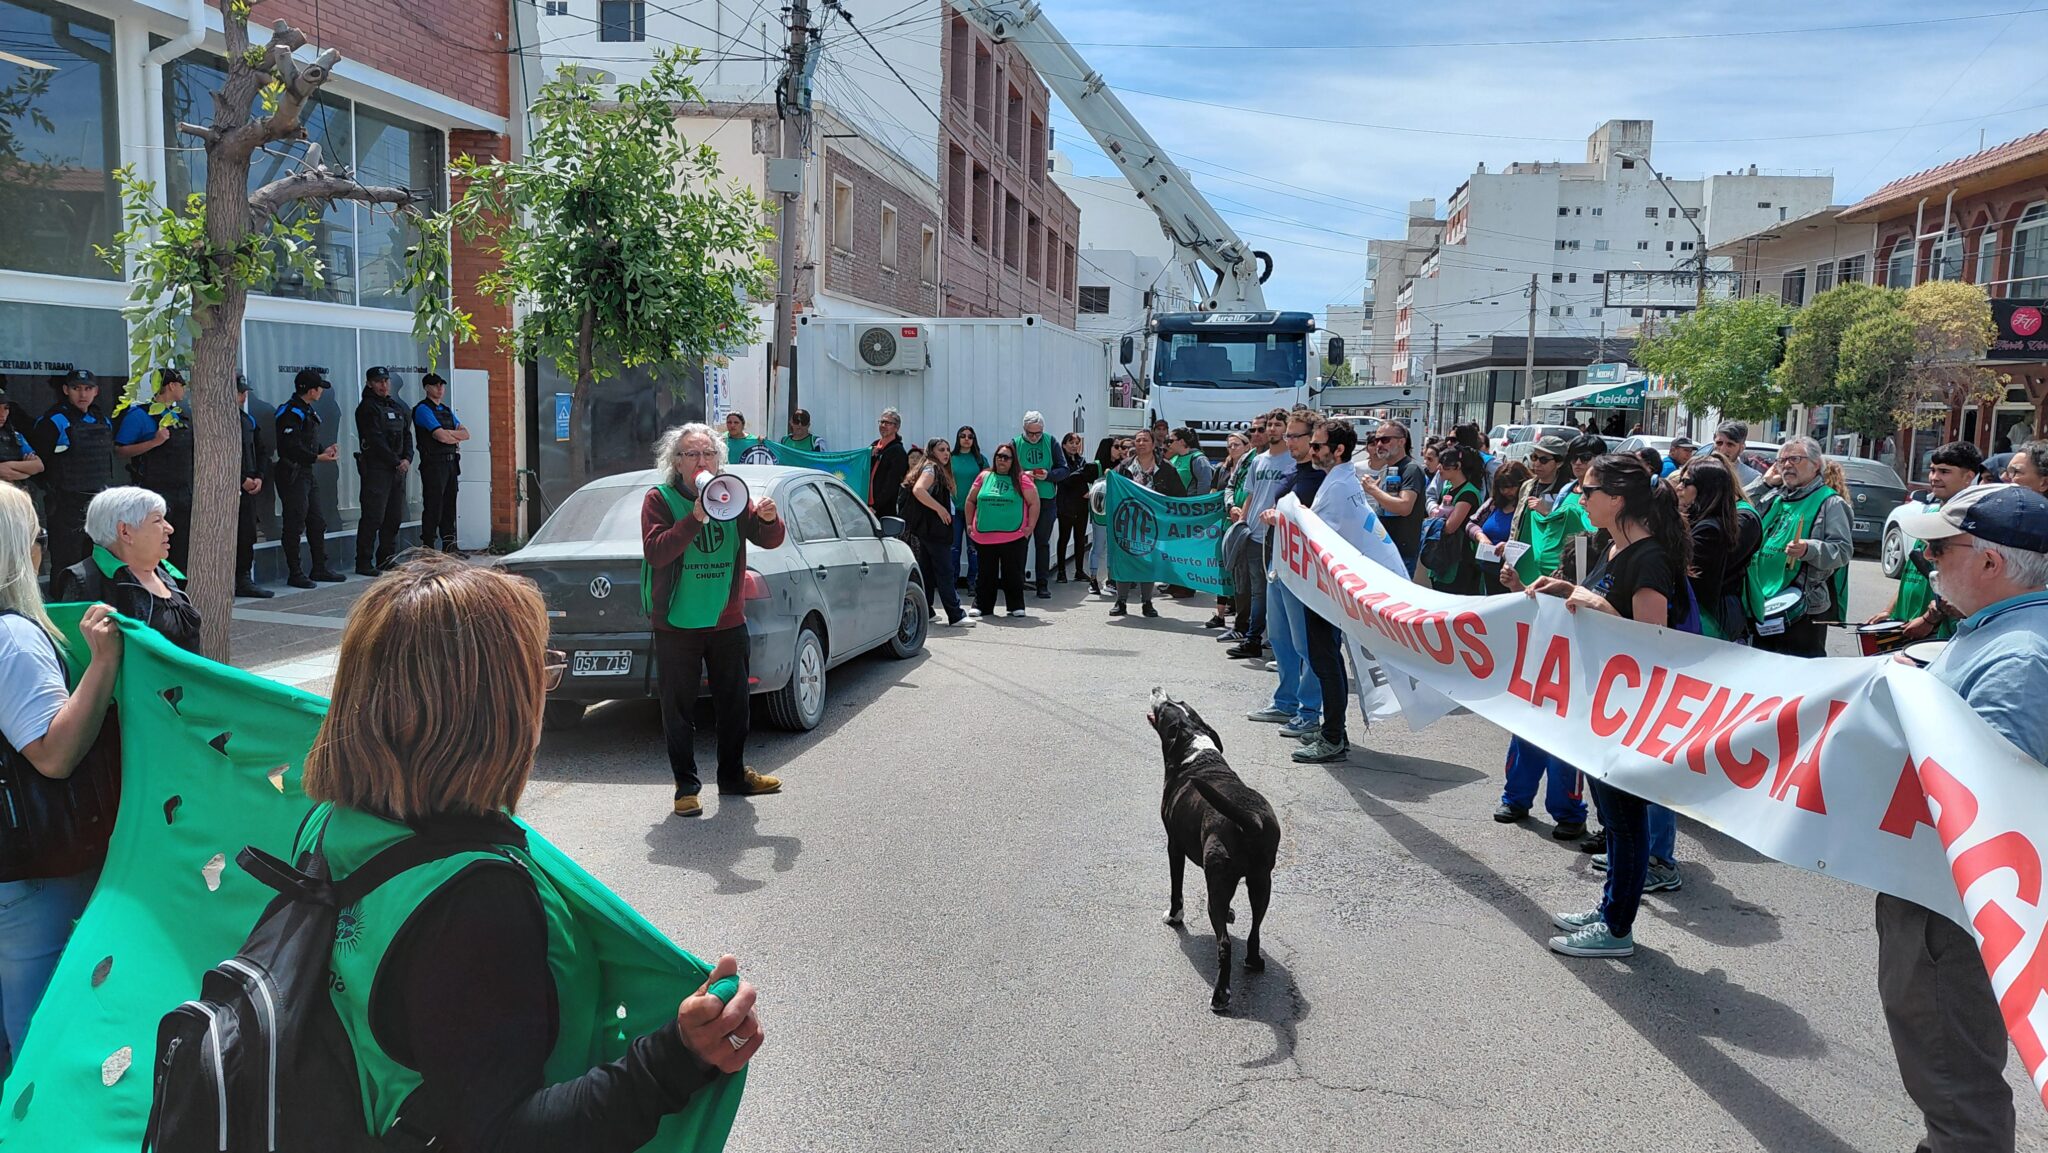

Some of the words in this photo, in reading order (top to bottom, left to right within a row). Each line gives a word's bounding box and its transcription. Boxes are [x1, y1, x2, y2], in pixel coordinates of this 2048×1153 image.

[33, 361, 42, 370] DE
[44, 362, 74, 371] TRABAJO
[1595, 393, 1640, 405] beldent
[1201, 421, 1251, 431] IVECO
[1161, 552, 1203, 567] Puerto
[695, 571, 726, 579] CHUBUT
[1186, 571, 1234, 586] Chubut
[575, 656, 599, 671] OSX
[606, 656, 630, 671] 719
[1507, 621, 1571, 718] LA
[1590, 653, 1849, 816] CIENCIA
